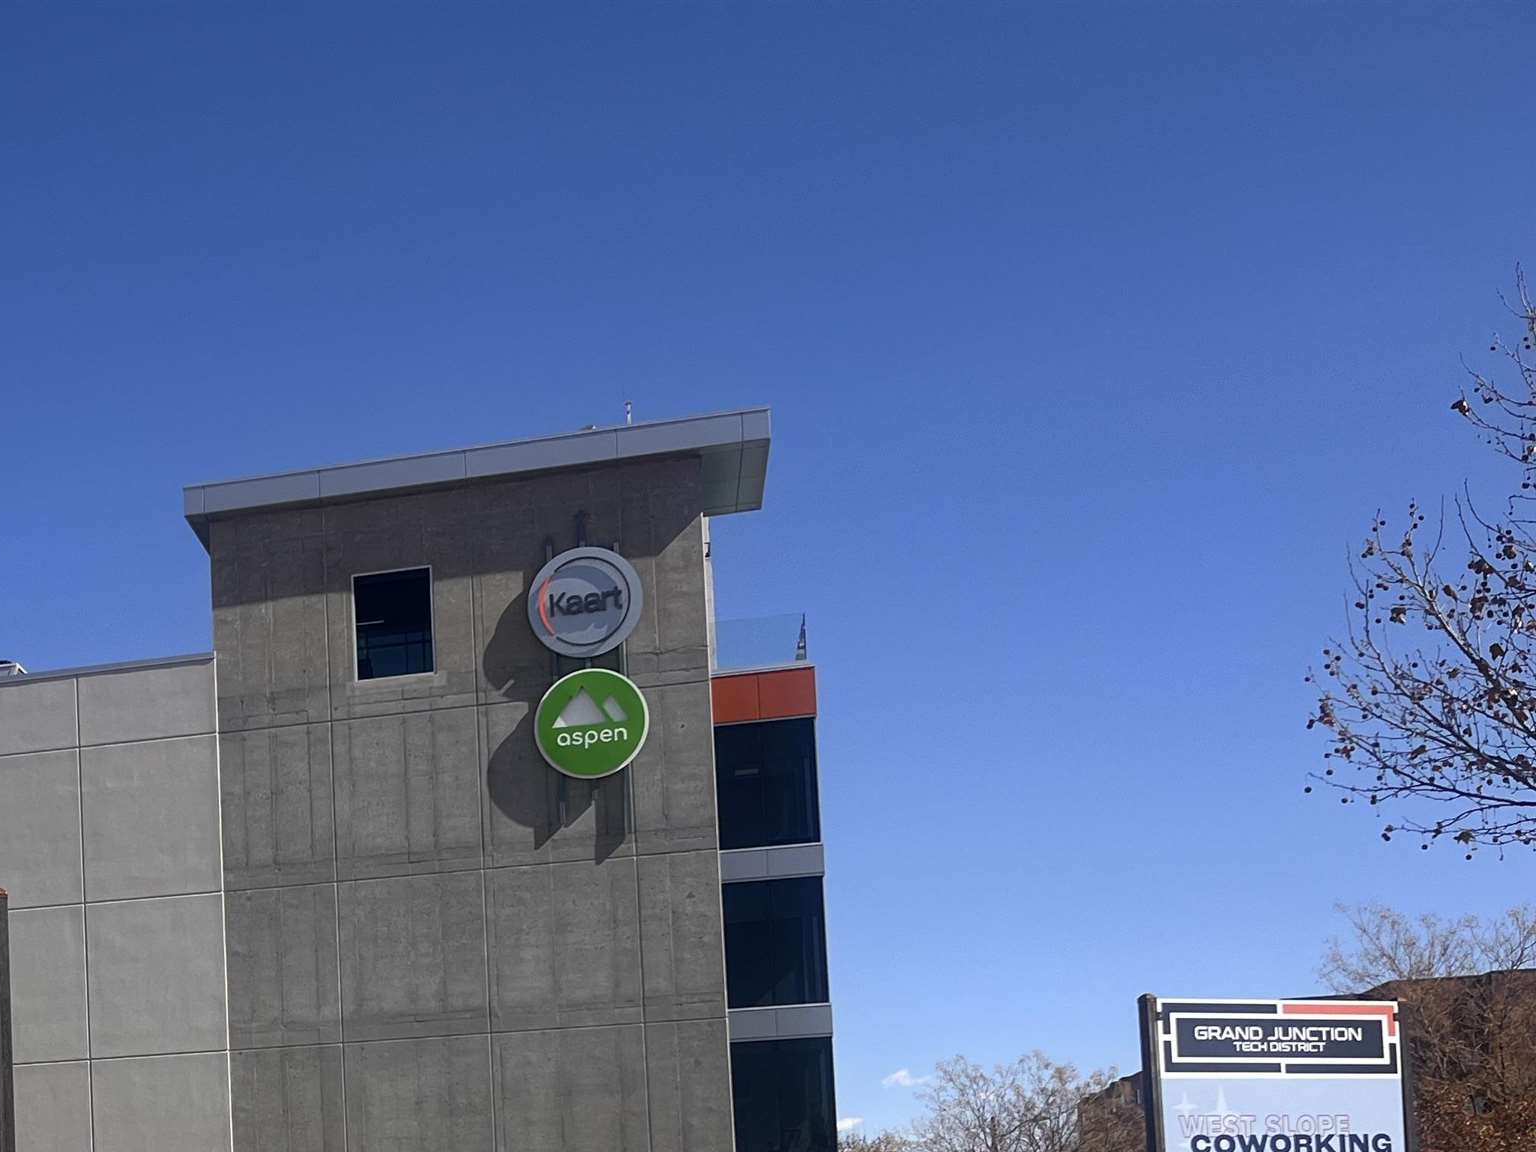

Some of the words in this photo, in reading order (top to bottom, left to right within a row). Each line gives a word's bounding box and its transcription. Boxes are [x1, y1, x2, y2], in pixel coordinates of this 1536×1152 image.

[549, 585, 623, 618] Kaart
[557, 727, 627, 748] aspen
[1195, 1026, 1262, 1040] GRAND
[1266, 1026, 1362, 1041] JUNCTION
[1234, 1042, 1268, 1052] TECH
[1270, 1042, 1326, 1052] DISTRICT
[1178, 1114, 1256, 1138] WEST
[1265, 1114, 1351, 1136] SLOPE
